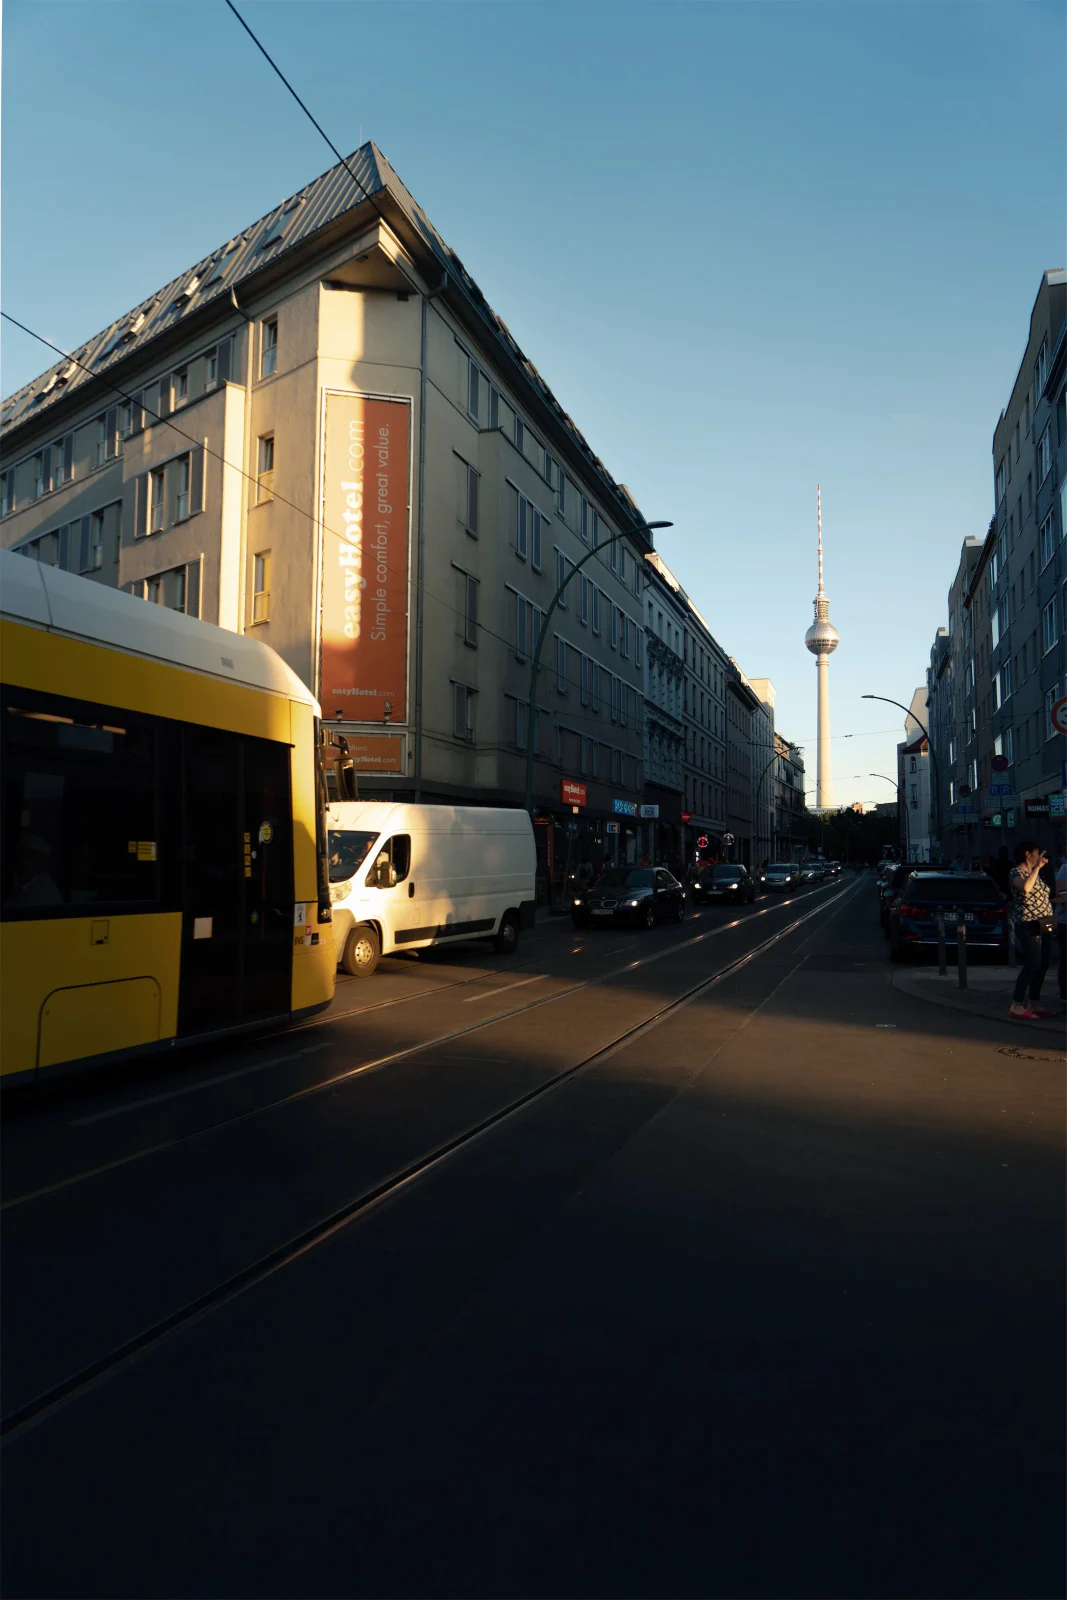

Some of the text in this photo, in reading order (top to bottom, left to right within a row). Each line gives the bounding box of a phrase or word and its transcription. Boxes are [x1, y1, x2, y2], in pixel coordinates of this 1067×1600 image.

[338, 420, 367, 639] easyHotel.com
[370, 423, 392, 641] Simple comfort, great value.
[331, 687, 395, 698] easyHotel.com
